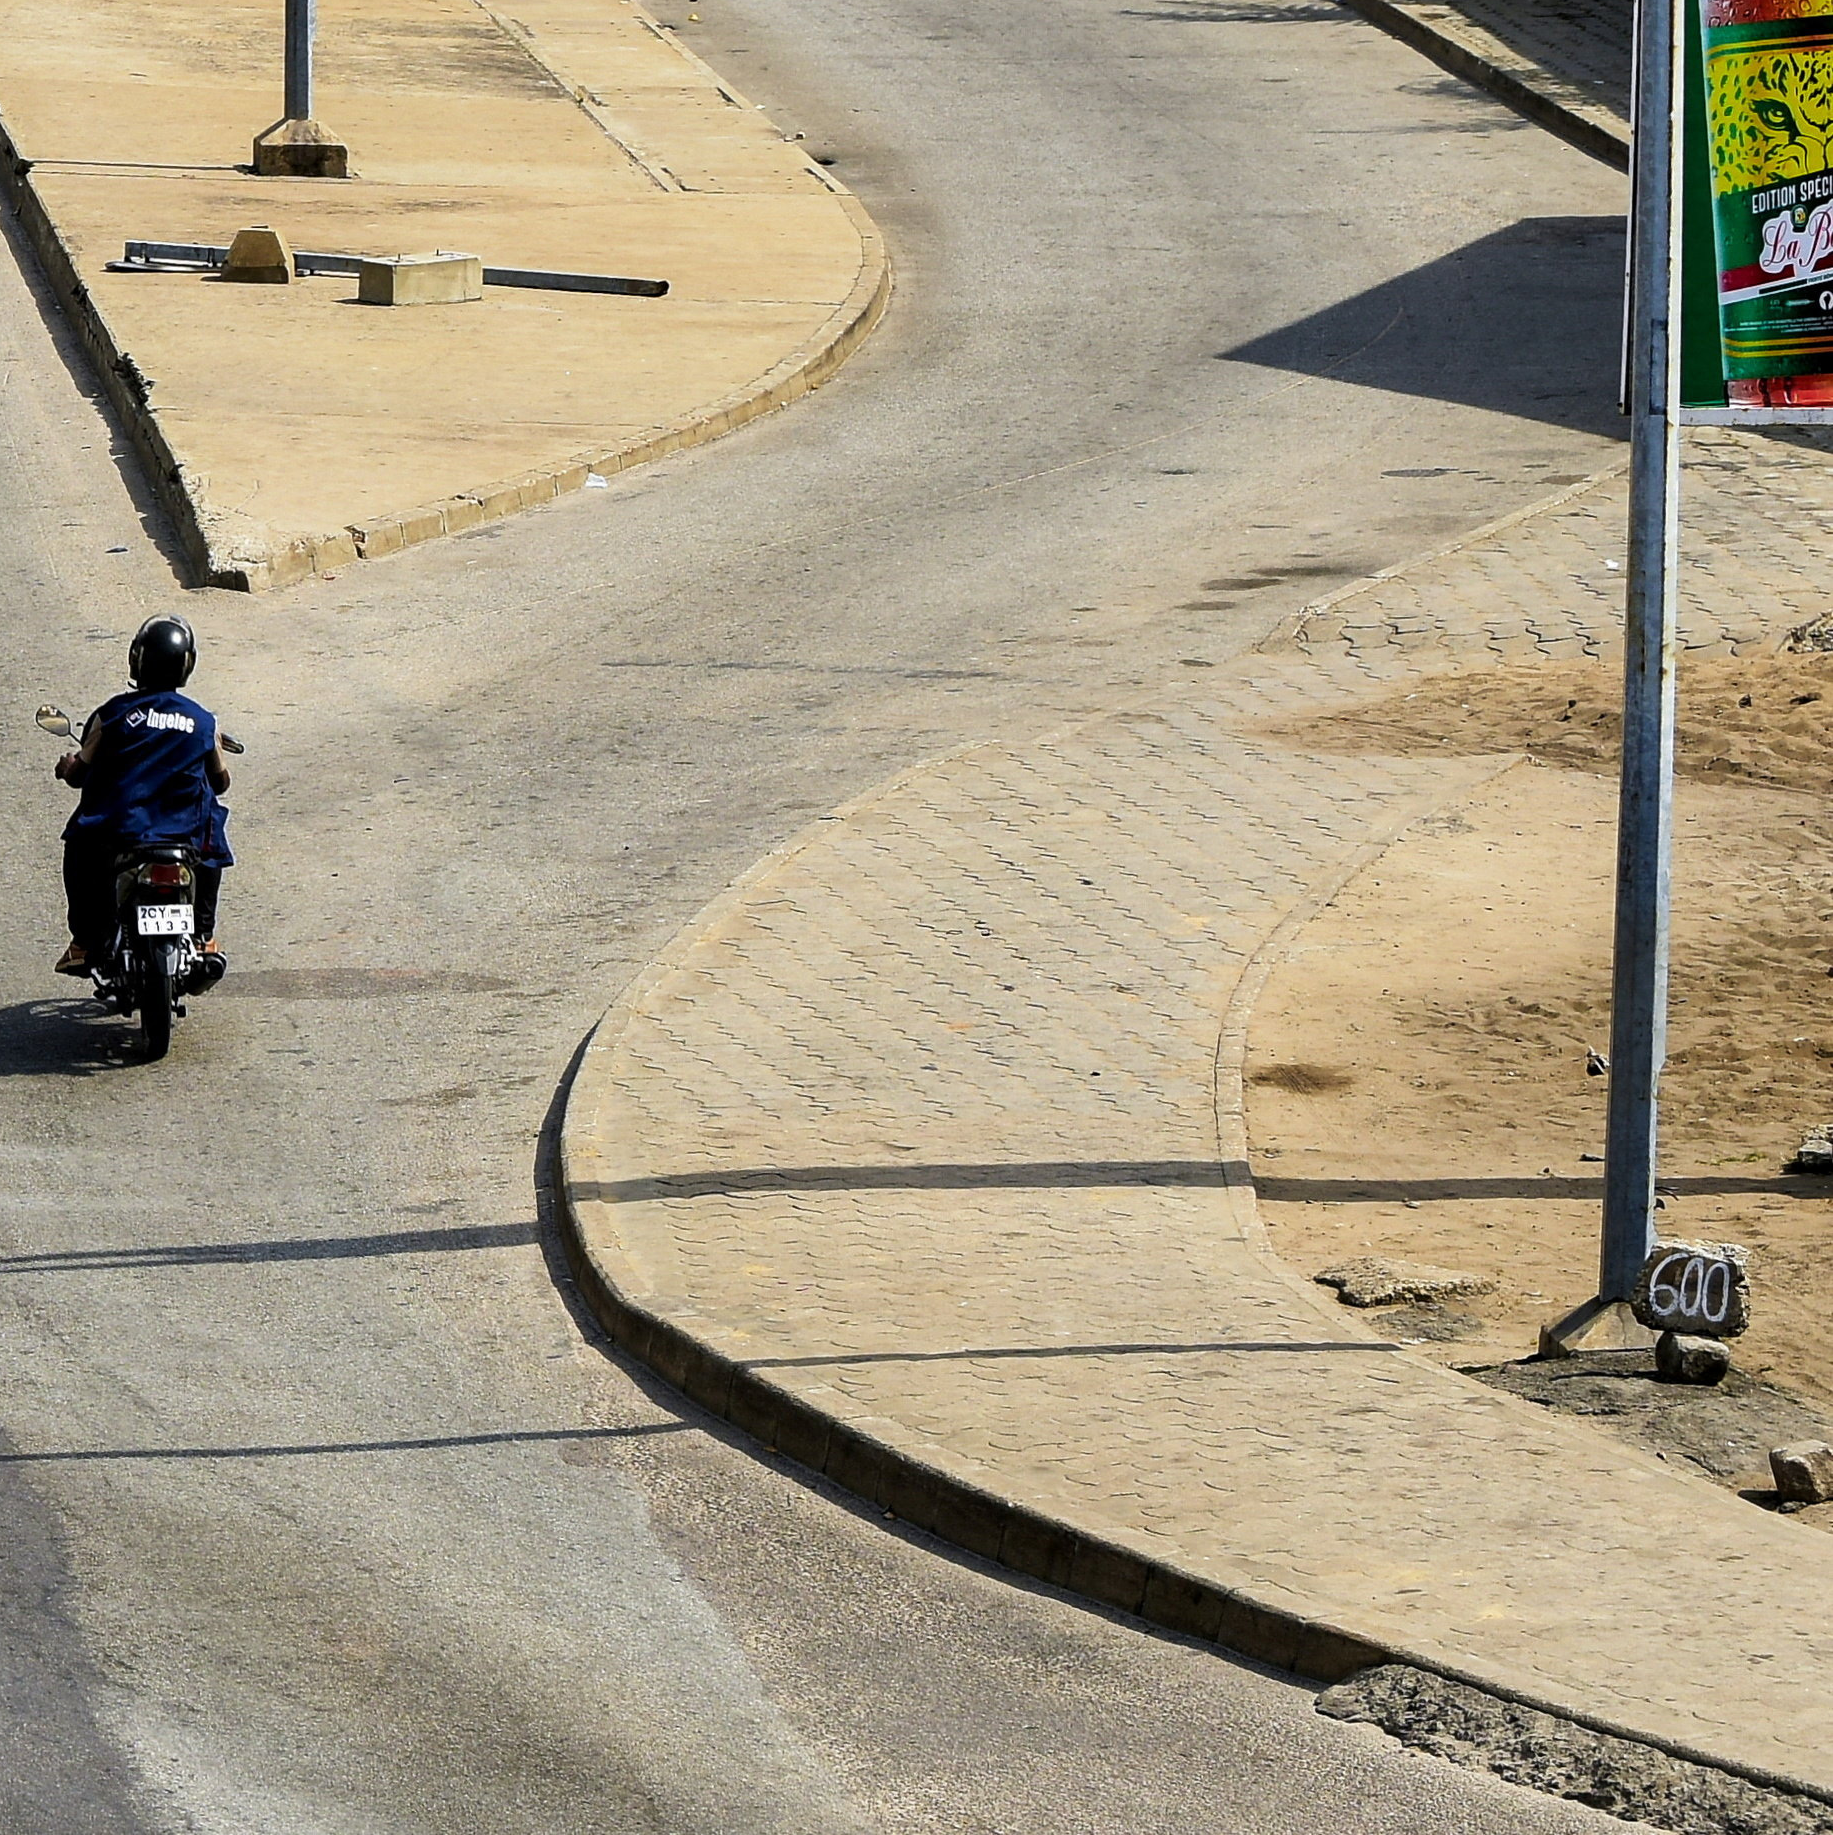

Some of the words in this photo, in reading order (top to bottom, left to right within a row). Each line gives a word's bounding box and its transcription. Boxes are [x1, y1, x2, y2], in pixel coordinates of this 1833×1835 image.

[1752, 184, 1796, 214] EDITION
[1799, 174, 1833, 202] SPÉCI
[1763, 220, 1801, 268] La
[146, 708, 195, 734] Ingelec
[143, 920, 188, 933] 1133
[1649, 1252, 1730, 1322] 600
